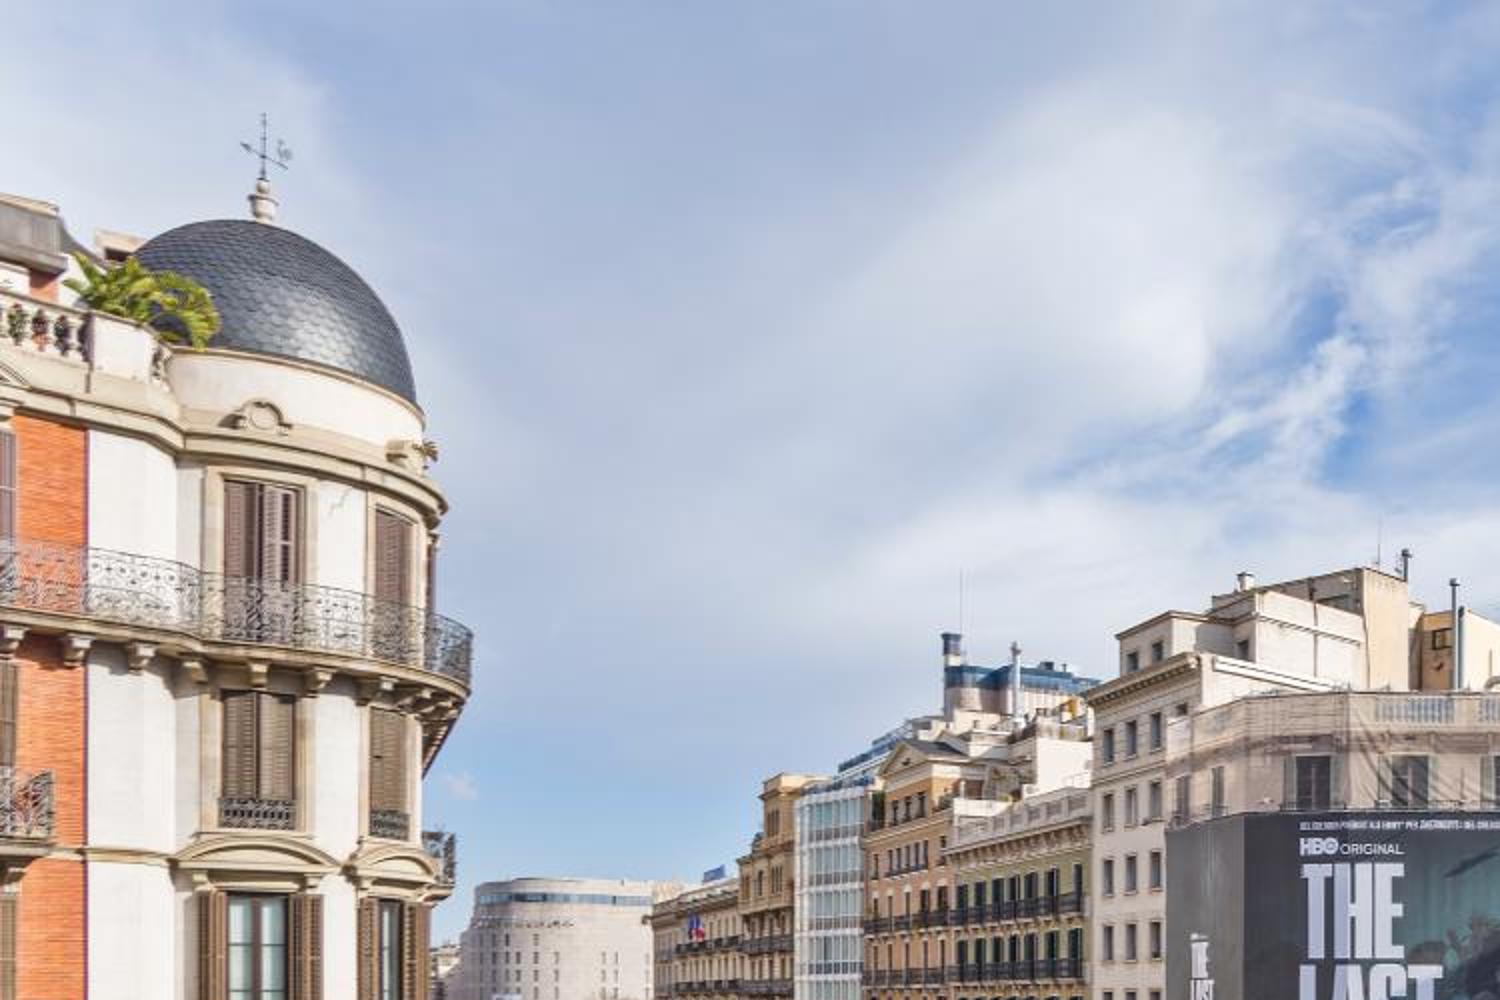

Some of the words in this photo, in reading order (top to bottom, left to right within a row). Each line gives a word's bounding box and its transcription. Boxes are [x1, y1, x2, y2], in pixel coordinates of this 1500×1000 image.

[1299, 837, 1338, 856] HBO
[1340, 843, 1405, 855] ORIGINAL
[1300, 863, 1405, 960] THE
